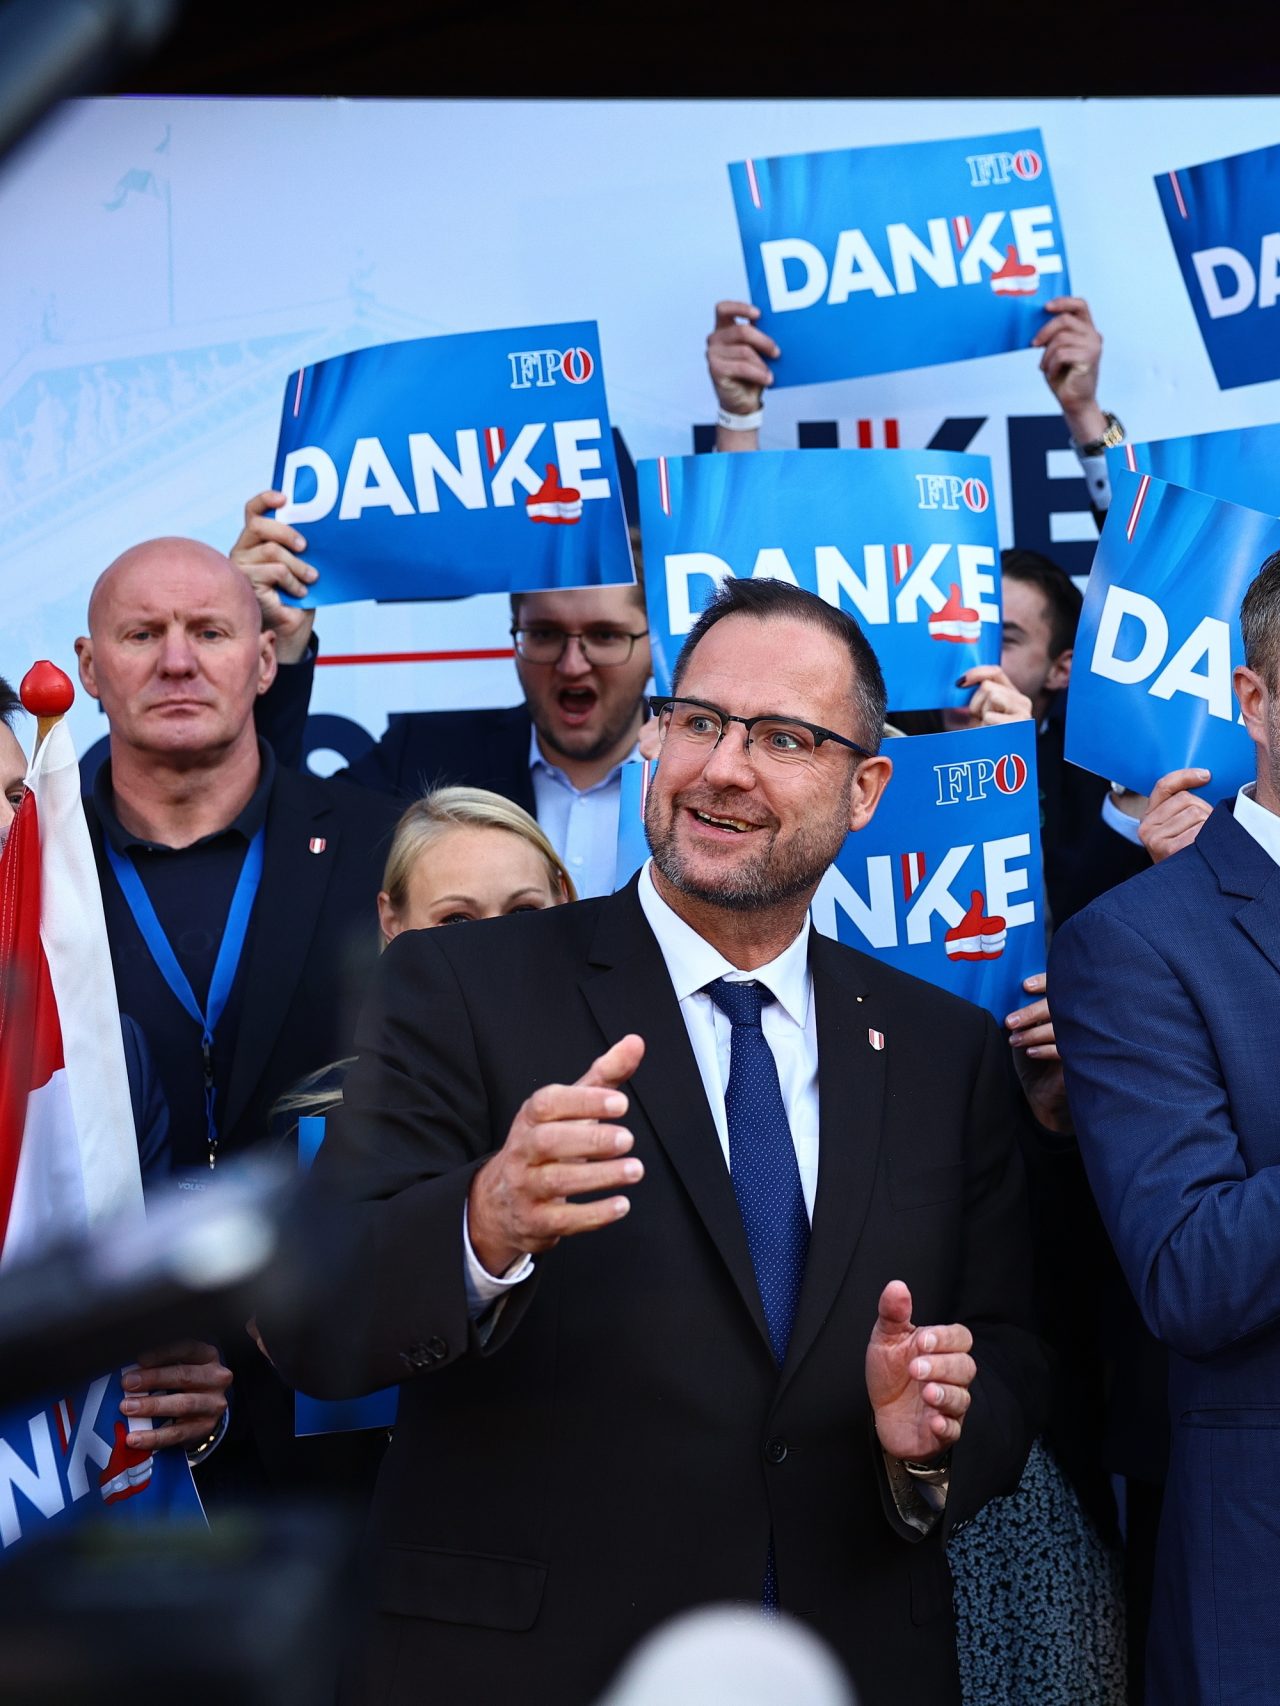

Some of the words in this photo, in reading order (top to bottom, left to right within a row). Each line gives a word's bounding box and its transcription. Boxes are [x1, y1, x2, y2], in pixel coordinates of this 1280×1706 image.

[760, 205, 1063, 313] DANKE
[275, 418, 611, 525] DANKE
[810, 833, 1035, 949] NKE
